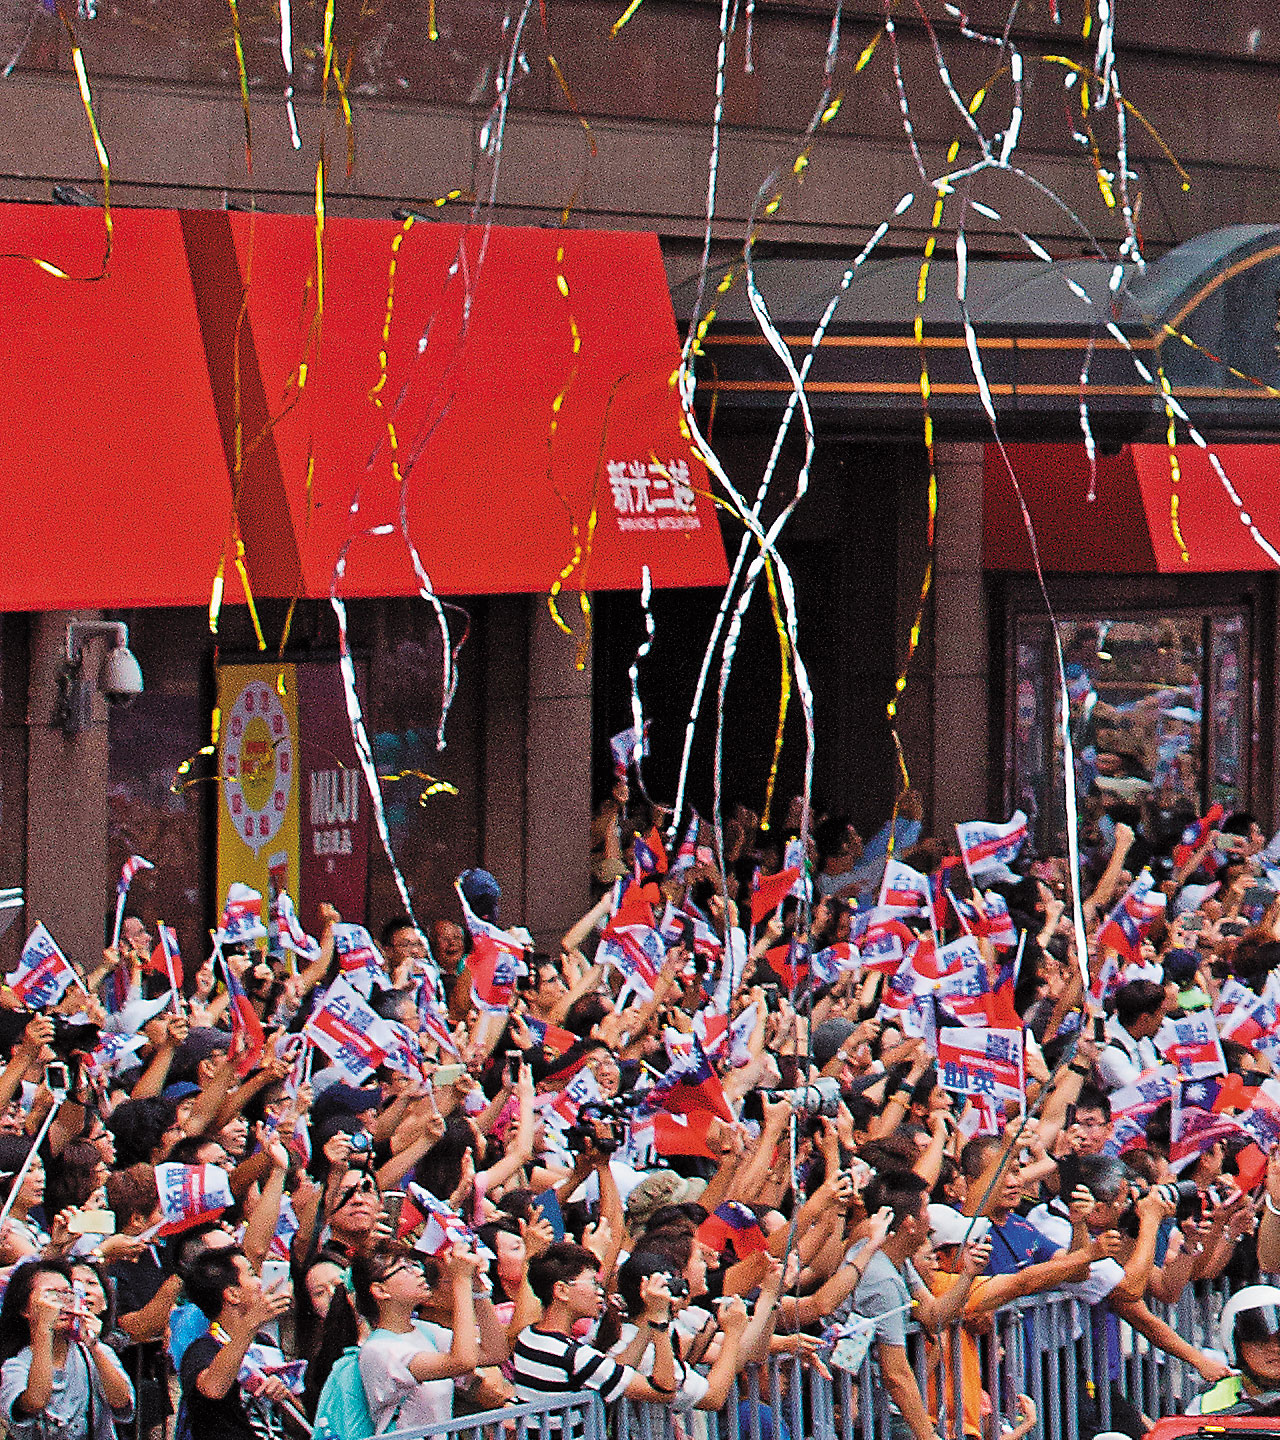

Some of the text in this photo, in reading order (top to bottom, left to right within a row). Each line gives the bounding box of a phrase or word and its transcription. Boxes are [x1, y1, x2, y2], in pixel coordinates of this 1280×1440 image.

[607, 459, 697, 514] 新光三越
[311, 769, 358, 824] MUJI
